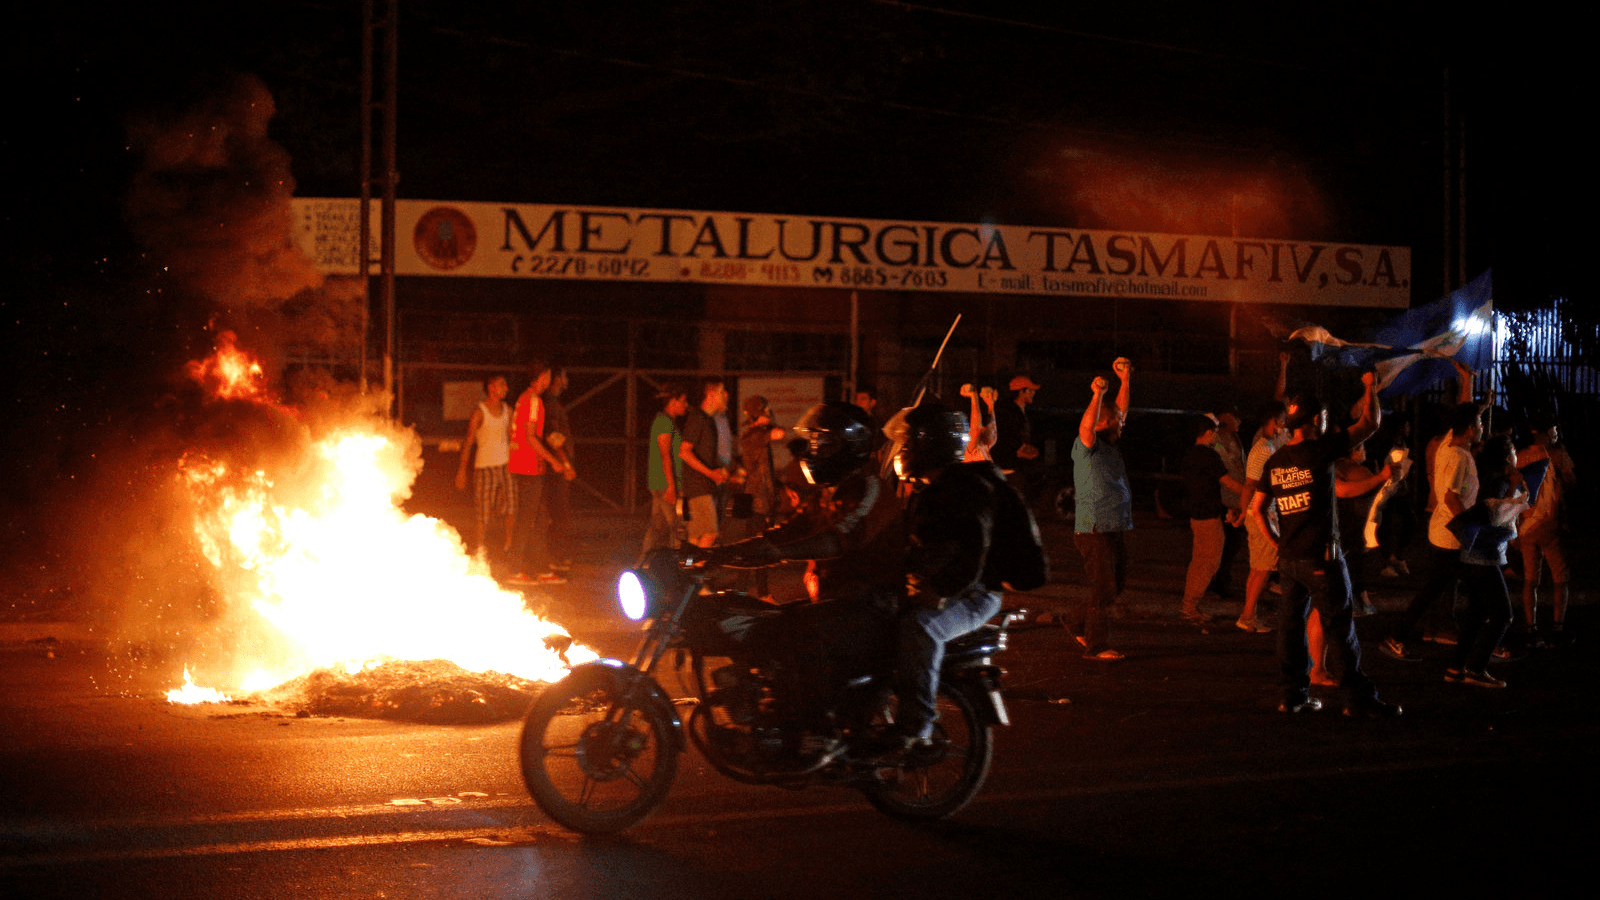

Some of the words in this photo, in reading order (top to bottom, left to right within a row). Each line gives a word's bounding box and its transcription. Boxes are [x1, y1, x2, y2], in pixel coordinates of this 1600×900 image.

[501, 207, 1015, 271] METALURGICA
[1281, 469, 1313, 484] LAFISE
[1277, 491, 1311, 512] STAFF
